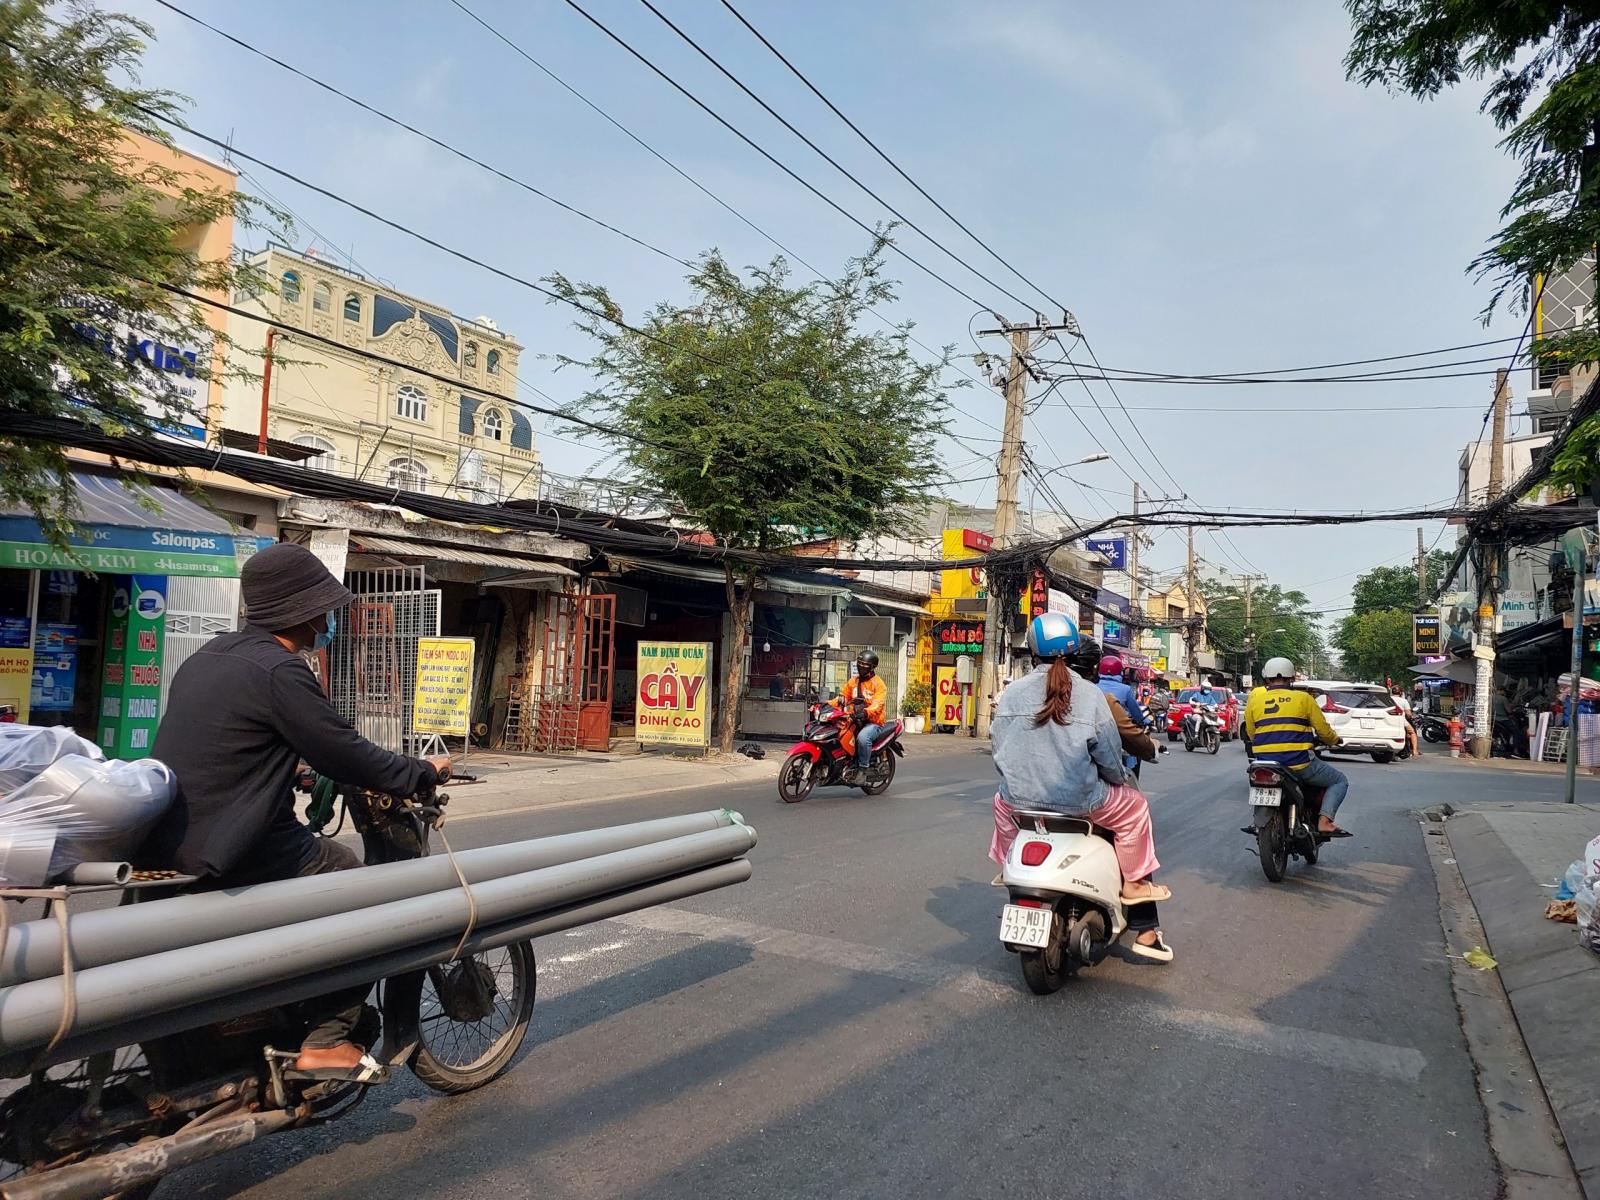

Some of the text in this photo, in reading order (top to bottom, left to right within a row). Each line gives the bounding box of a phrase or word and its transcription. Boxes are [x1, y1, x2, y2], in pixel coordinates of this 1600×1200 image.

[151, 531, 216, 550] Salonpas
[1097, 541, 1115, 551] NHÀ
[98, 554, 137, 568] KIM
[1502, 601, 1525, 611] Minh
[1419, 628, 1436, 636] MINH
[641, 646, 704, 660] NAM ĐỊNH QUÁN
[130, 656, 160, 686] THUỐC
[127, 695, 157, 718] HOÀNG
[673, 717, 701, 729] CAO
[1004, 924, 1045, 945] 737.37
